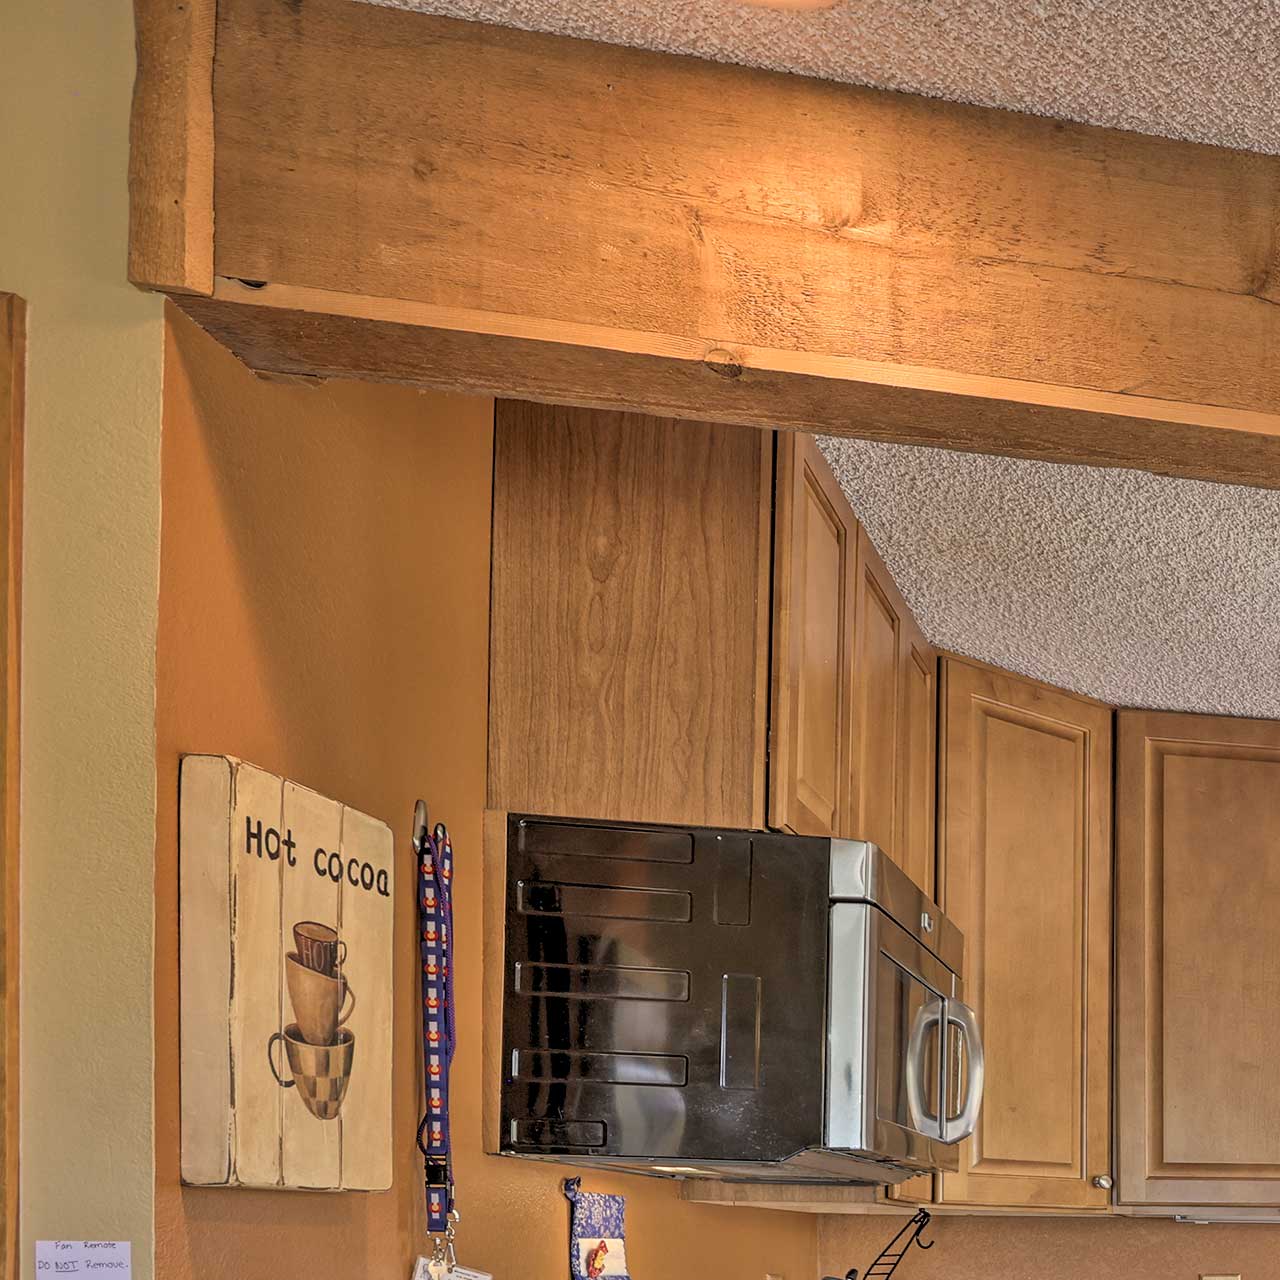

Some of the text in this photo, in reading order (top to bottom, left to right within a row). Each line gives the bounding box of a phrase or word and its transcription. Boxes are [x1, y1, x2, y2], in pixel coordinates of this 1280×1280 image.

[314, 848, 390, 897] cocoa
[55, 1240, 117, 1250] Fan Remote
[55, 1260, 79, 1270] NOT
